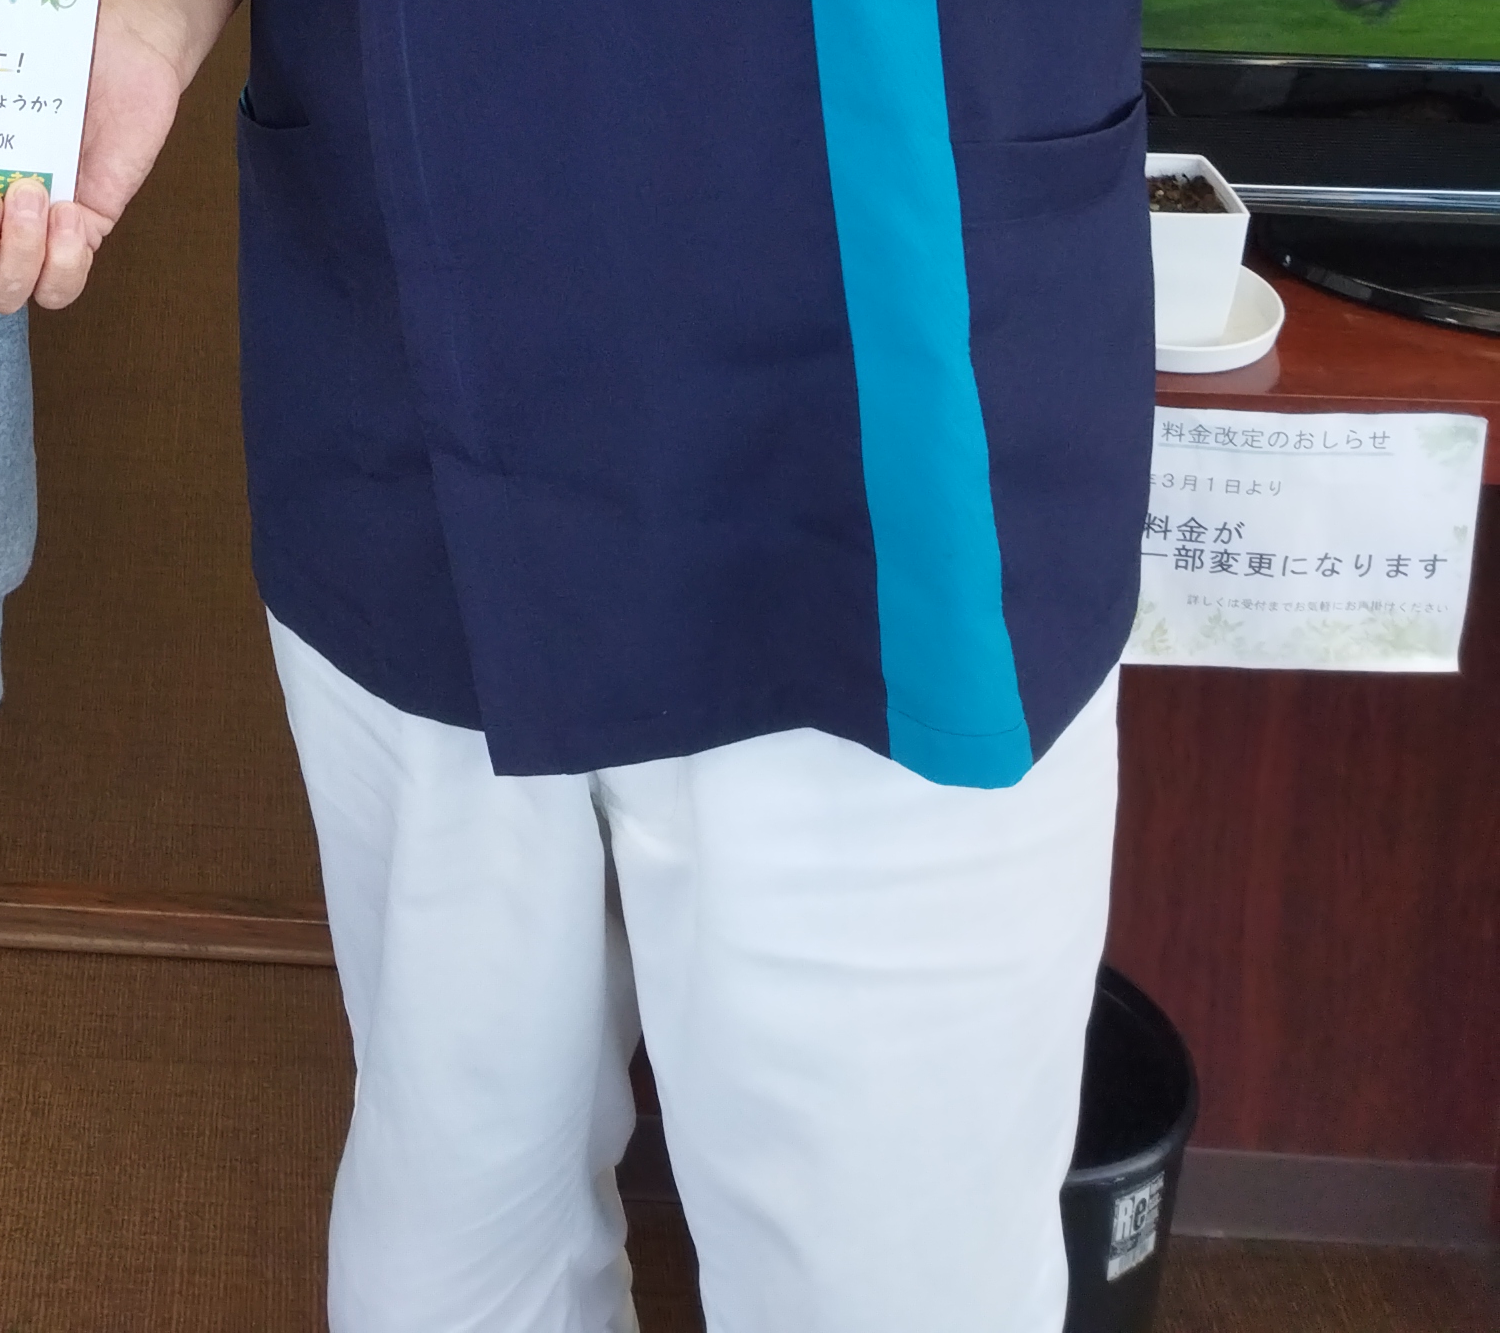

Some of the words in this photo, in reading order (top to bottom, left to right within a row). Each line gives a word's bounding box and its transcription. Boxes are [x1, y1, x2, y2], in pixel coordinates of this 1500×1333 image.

[1161, 421, 1391, 451] 料金改定のおしらせ
[1141, 546, 1448, 580] 一部変更になります
